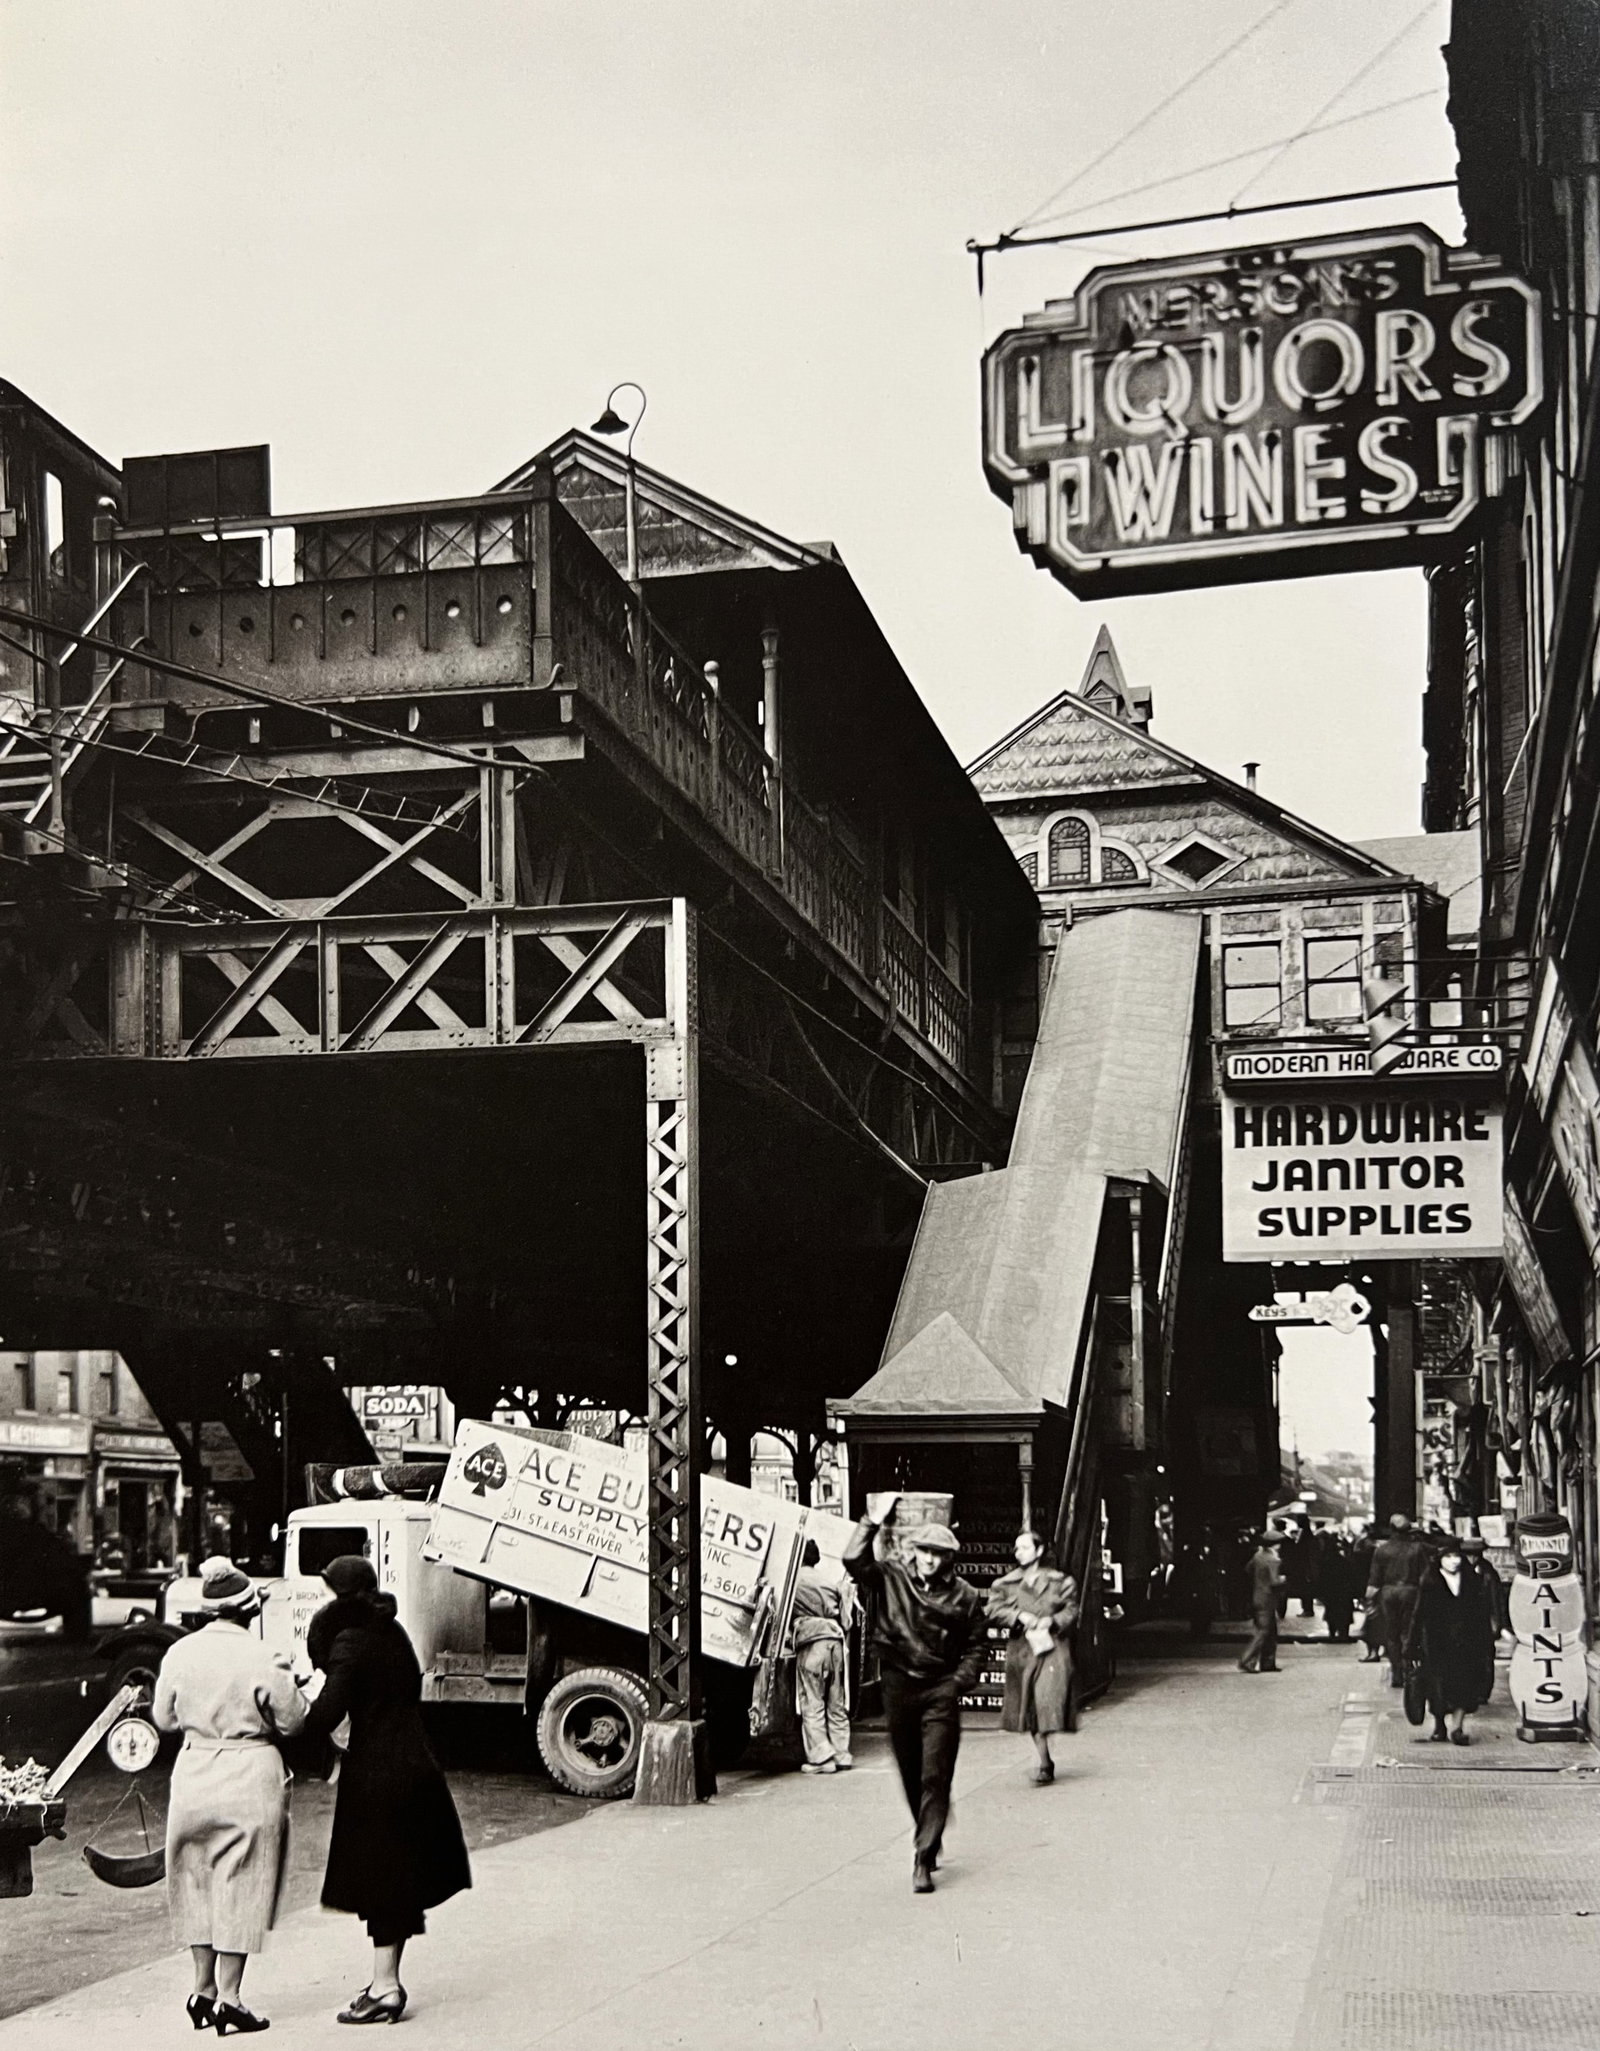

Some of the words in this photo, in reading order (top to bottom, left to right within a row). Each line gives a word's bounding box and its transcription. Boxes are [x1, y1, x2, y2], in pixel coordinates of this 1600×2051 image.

[1017, 301, 1511, 449] LIQUORS
[1101, 416, 1418, 542] WINES
[1232, 1055, 1329, 1075] MODERN
[1339, 1049, 1459, 1072] HAWARE
[1467, 1048, 1499, 1068] CO.
[1234, 1102, 1490, 1148] HARDWARE
[1252, 1155, 1465, 1191] JANITOR
[1257, 1203, 1472, 1236] SUPPLIES
[1255, 1307, 1288, 1318] KEYS
[366, 1396, 424, 1415] SODA
[467, 1454, 505, 1479] ACE
[519, 1448, 586, 1491] ACE
[538, 1488, 649, 1538] SUPPLY
[551, 1520, 583, 1542] EAST
[586, 1529, 623, 1555] RIVER
[1527, 1558, 1564, 1705] PAINTS
